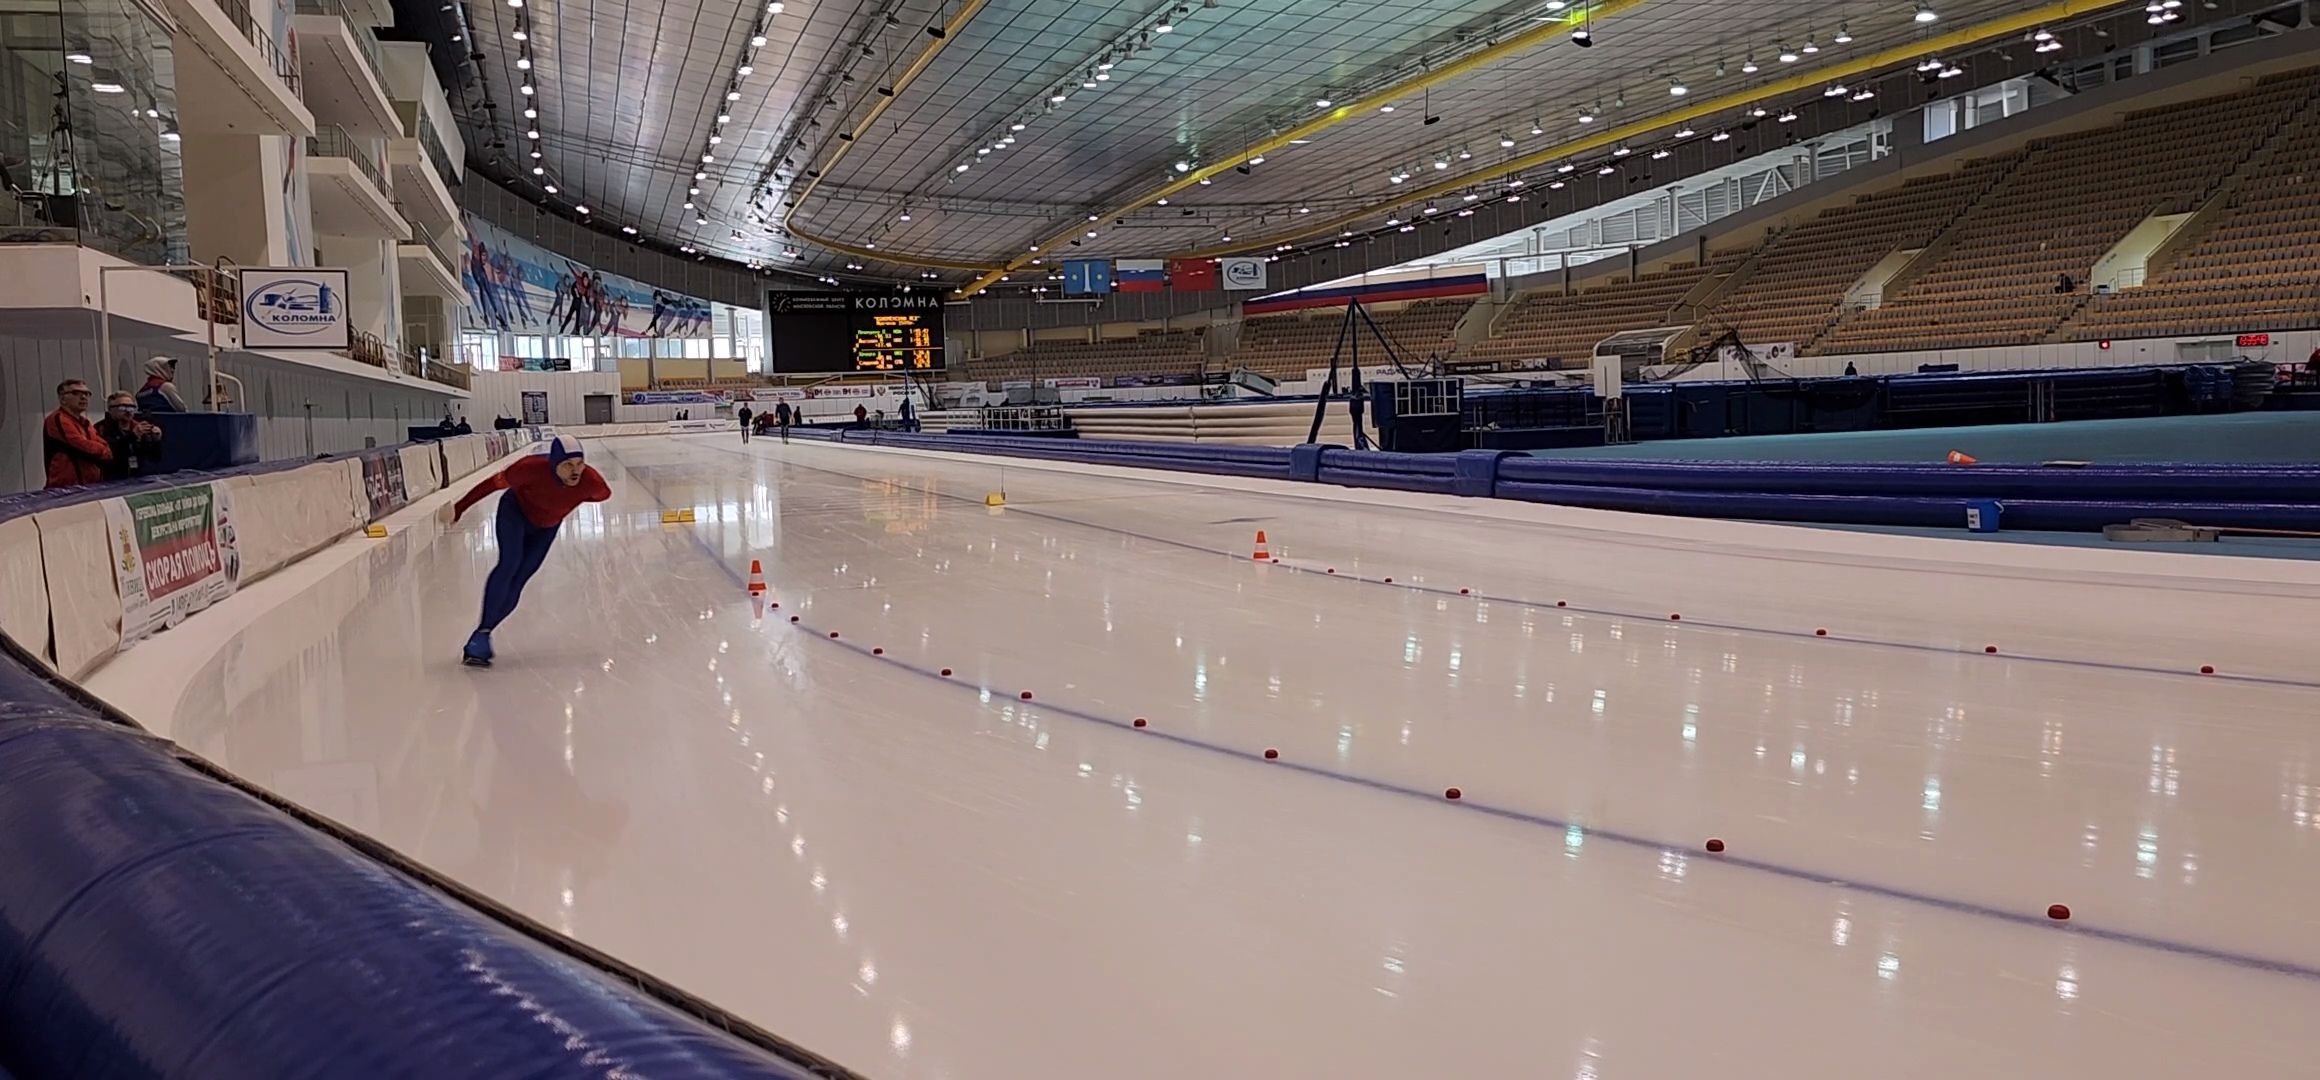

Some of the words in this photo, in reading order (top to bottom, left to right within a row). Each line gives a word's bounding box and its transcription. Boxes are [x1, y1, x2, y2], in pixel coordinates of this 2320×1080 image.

[855, 296, 939, 309] КОЛОМНА
[145, 551, 187, 591] СКОРАЯ
[182, 541, 216, 575] ПОМОЩЬ
